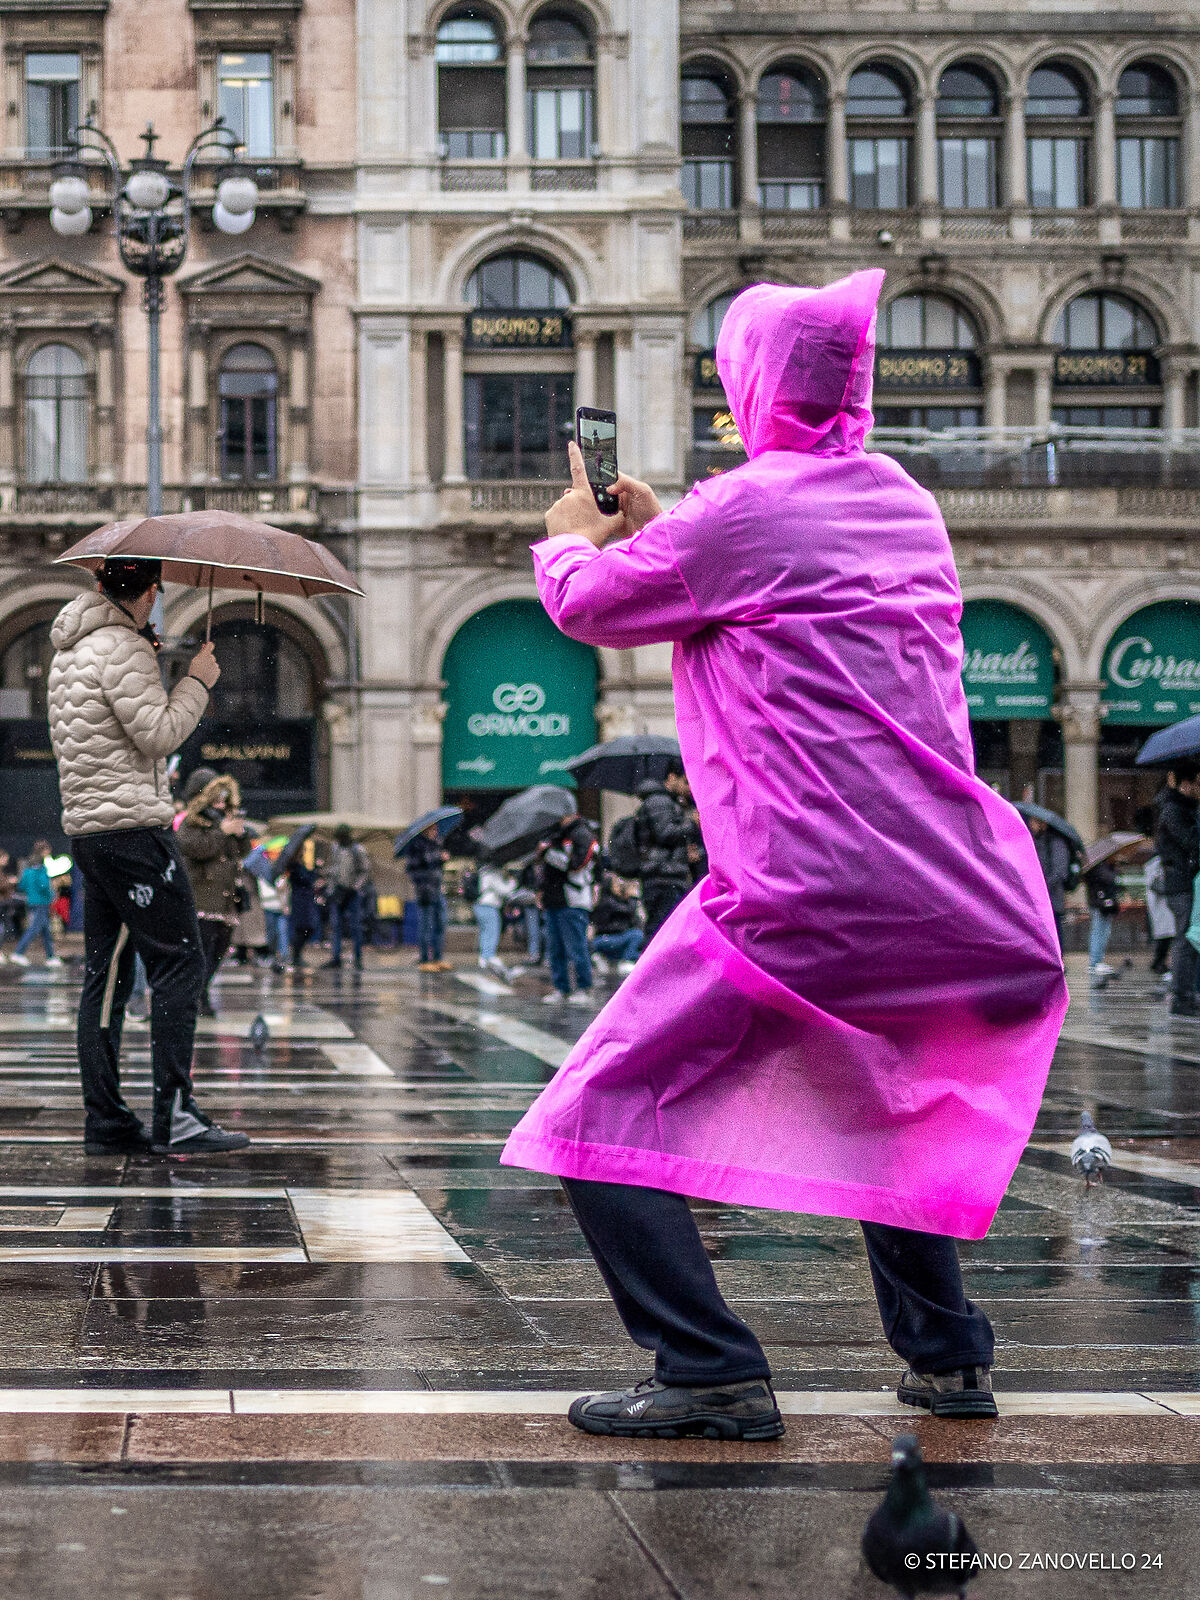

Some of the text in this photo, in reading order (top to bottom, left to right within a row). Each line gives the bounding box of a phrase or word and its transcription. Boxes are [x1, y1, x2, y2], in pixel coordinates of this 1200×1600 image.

[471, 317, 540, 336] DUOMO
[878, 358, 946, 376] DUOMO
[1057, 356, 1124, 375] DUOMO
